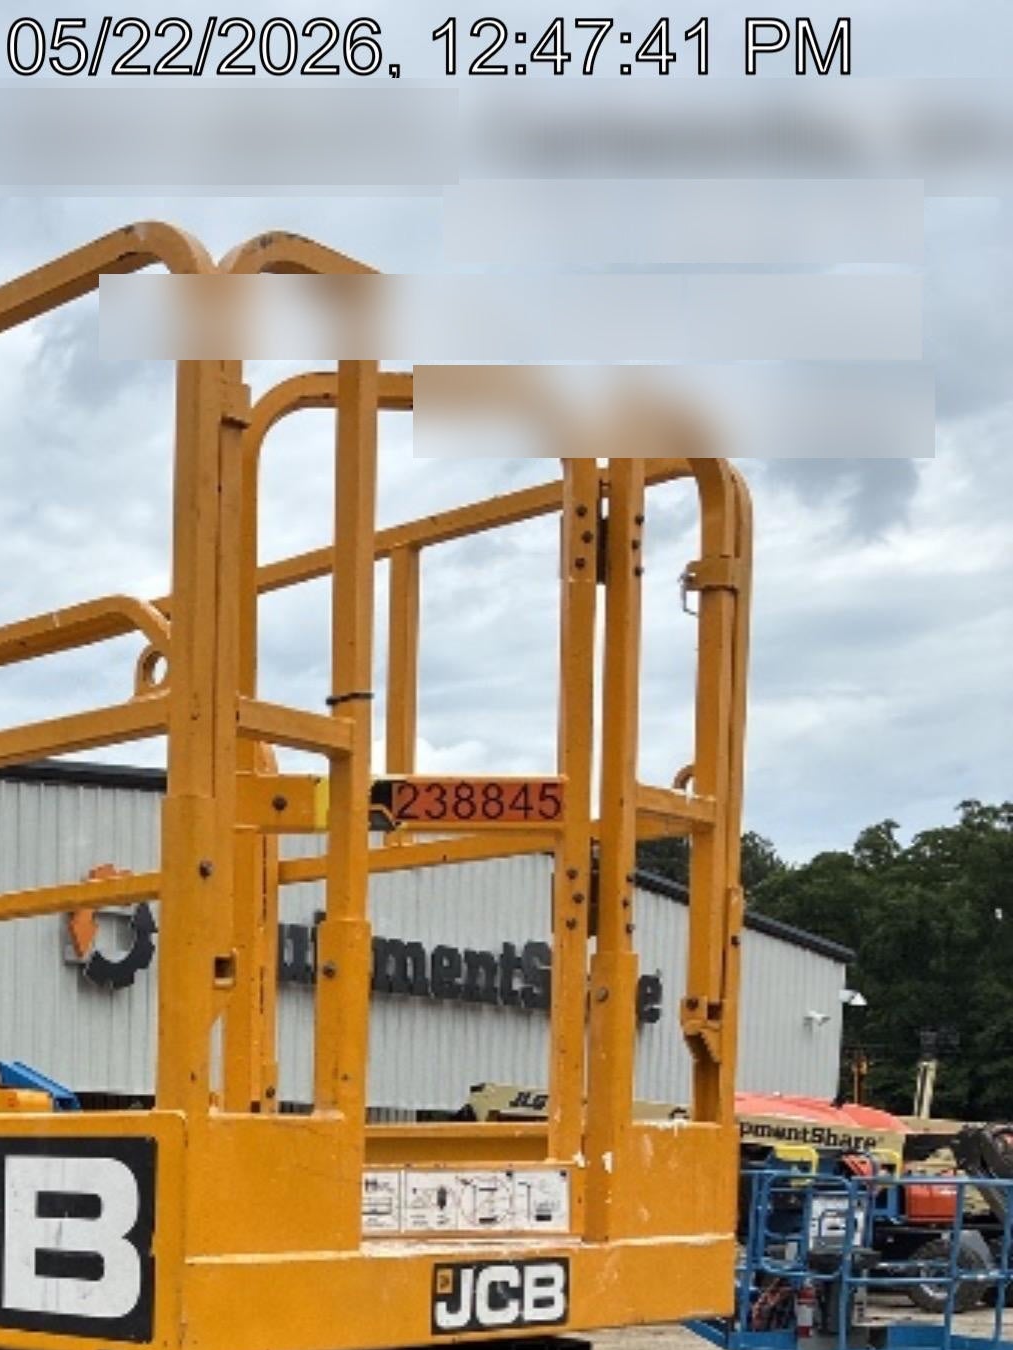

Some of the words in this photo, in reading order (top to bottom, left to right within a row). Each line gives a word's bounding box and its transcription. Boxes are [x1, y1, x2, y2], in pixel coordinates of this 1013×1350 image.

[396, 781, 562, 821] 238845
[739, 1120, 878, 1148] pmentShare
[435, 1262, 566, 1330] JCB
